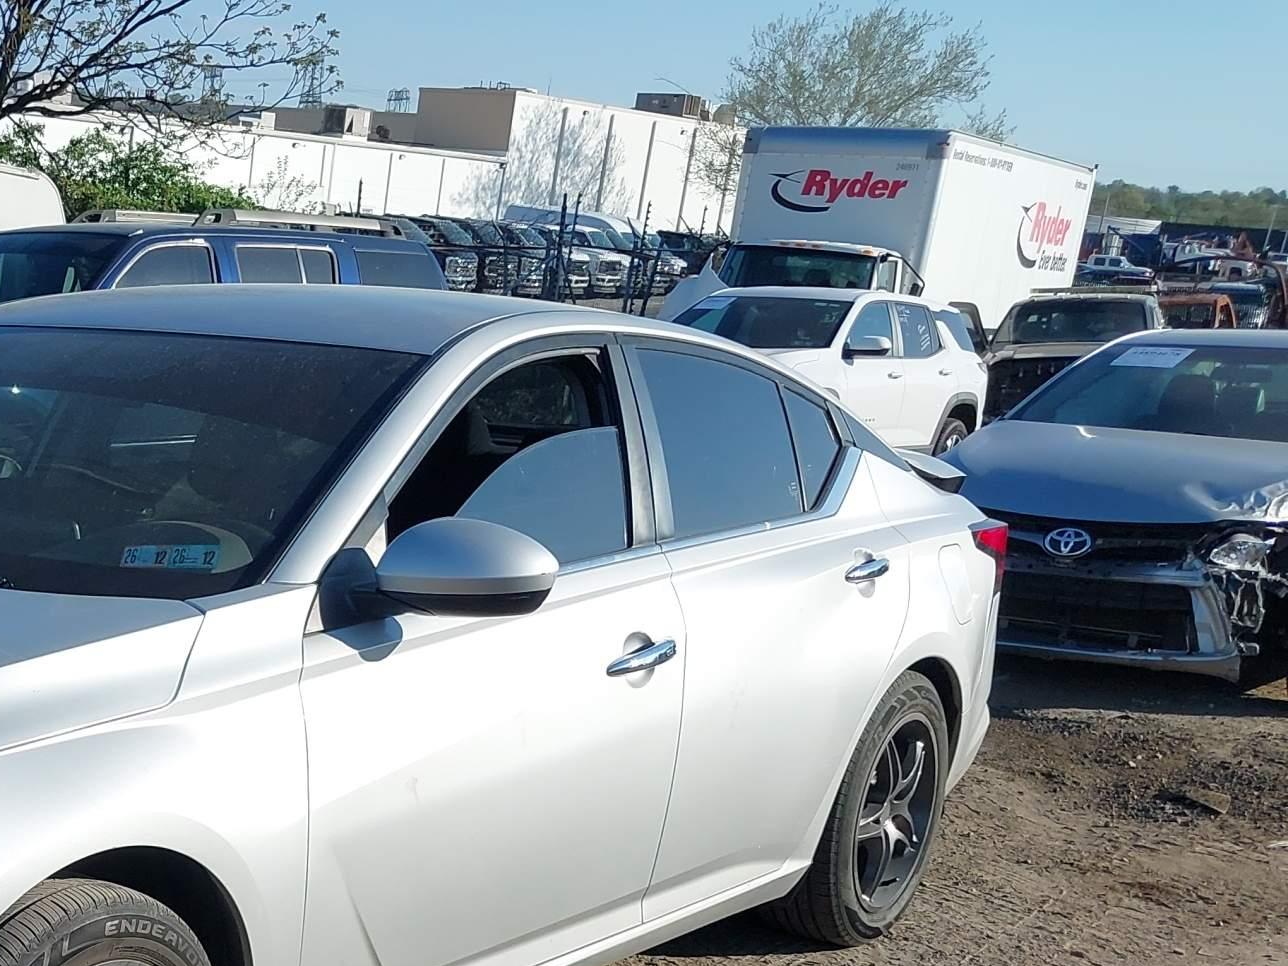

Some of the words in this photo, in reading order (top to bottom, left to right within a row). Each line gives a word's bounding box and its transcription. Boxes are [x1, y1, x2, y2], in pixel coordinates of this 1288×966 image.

[800, 169, 909, 204] Ryder
[1029, 201, 1072, 254] Ryder
[124, 548, 139, 564] 26
[154, 550, 167, 565] 12
[172, 548, 186, 564] 26
[202, 550, 216, 566] 12
